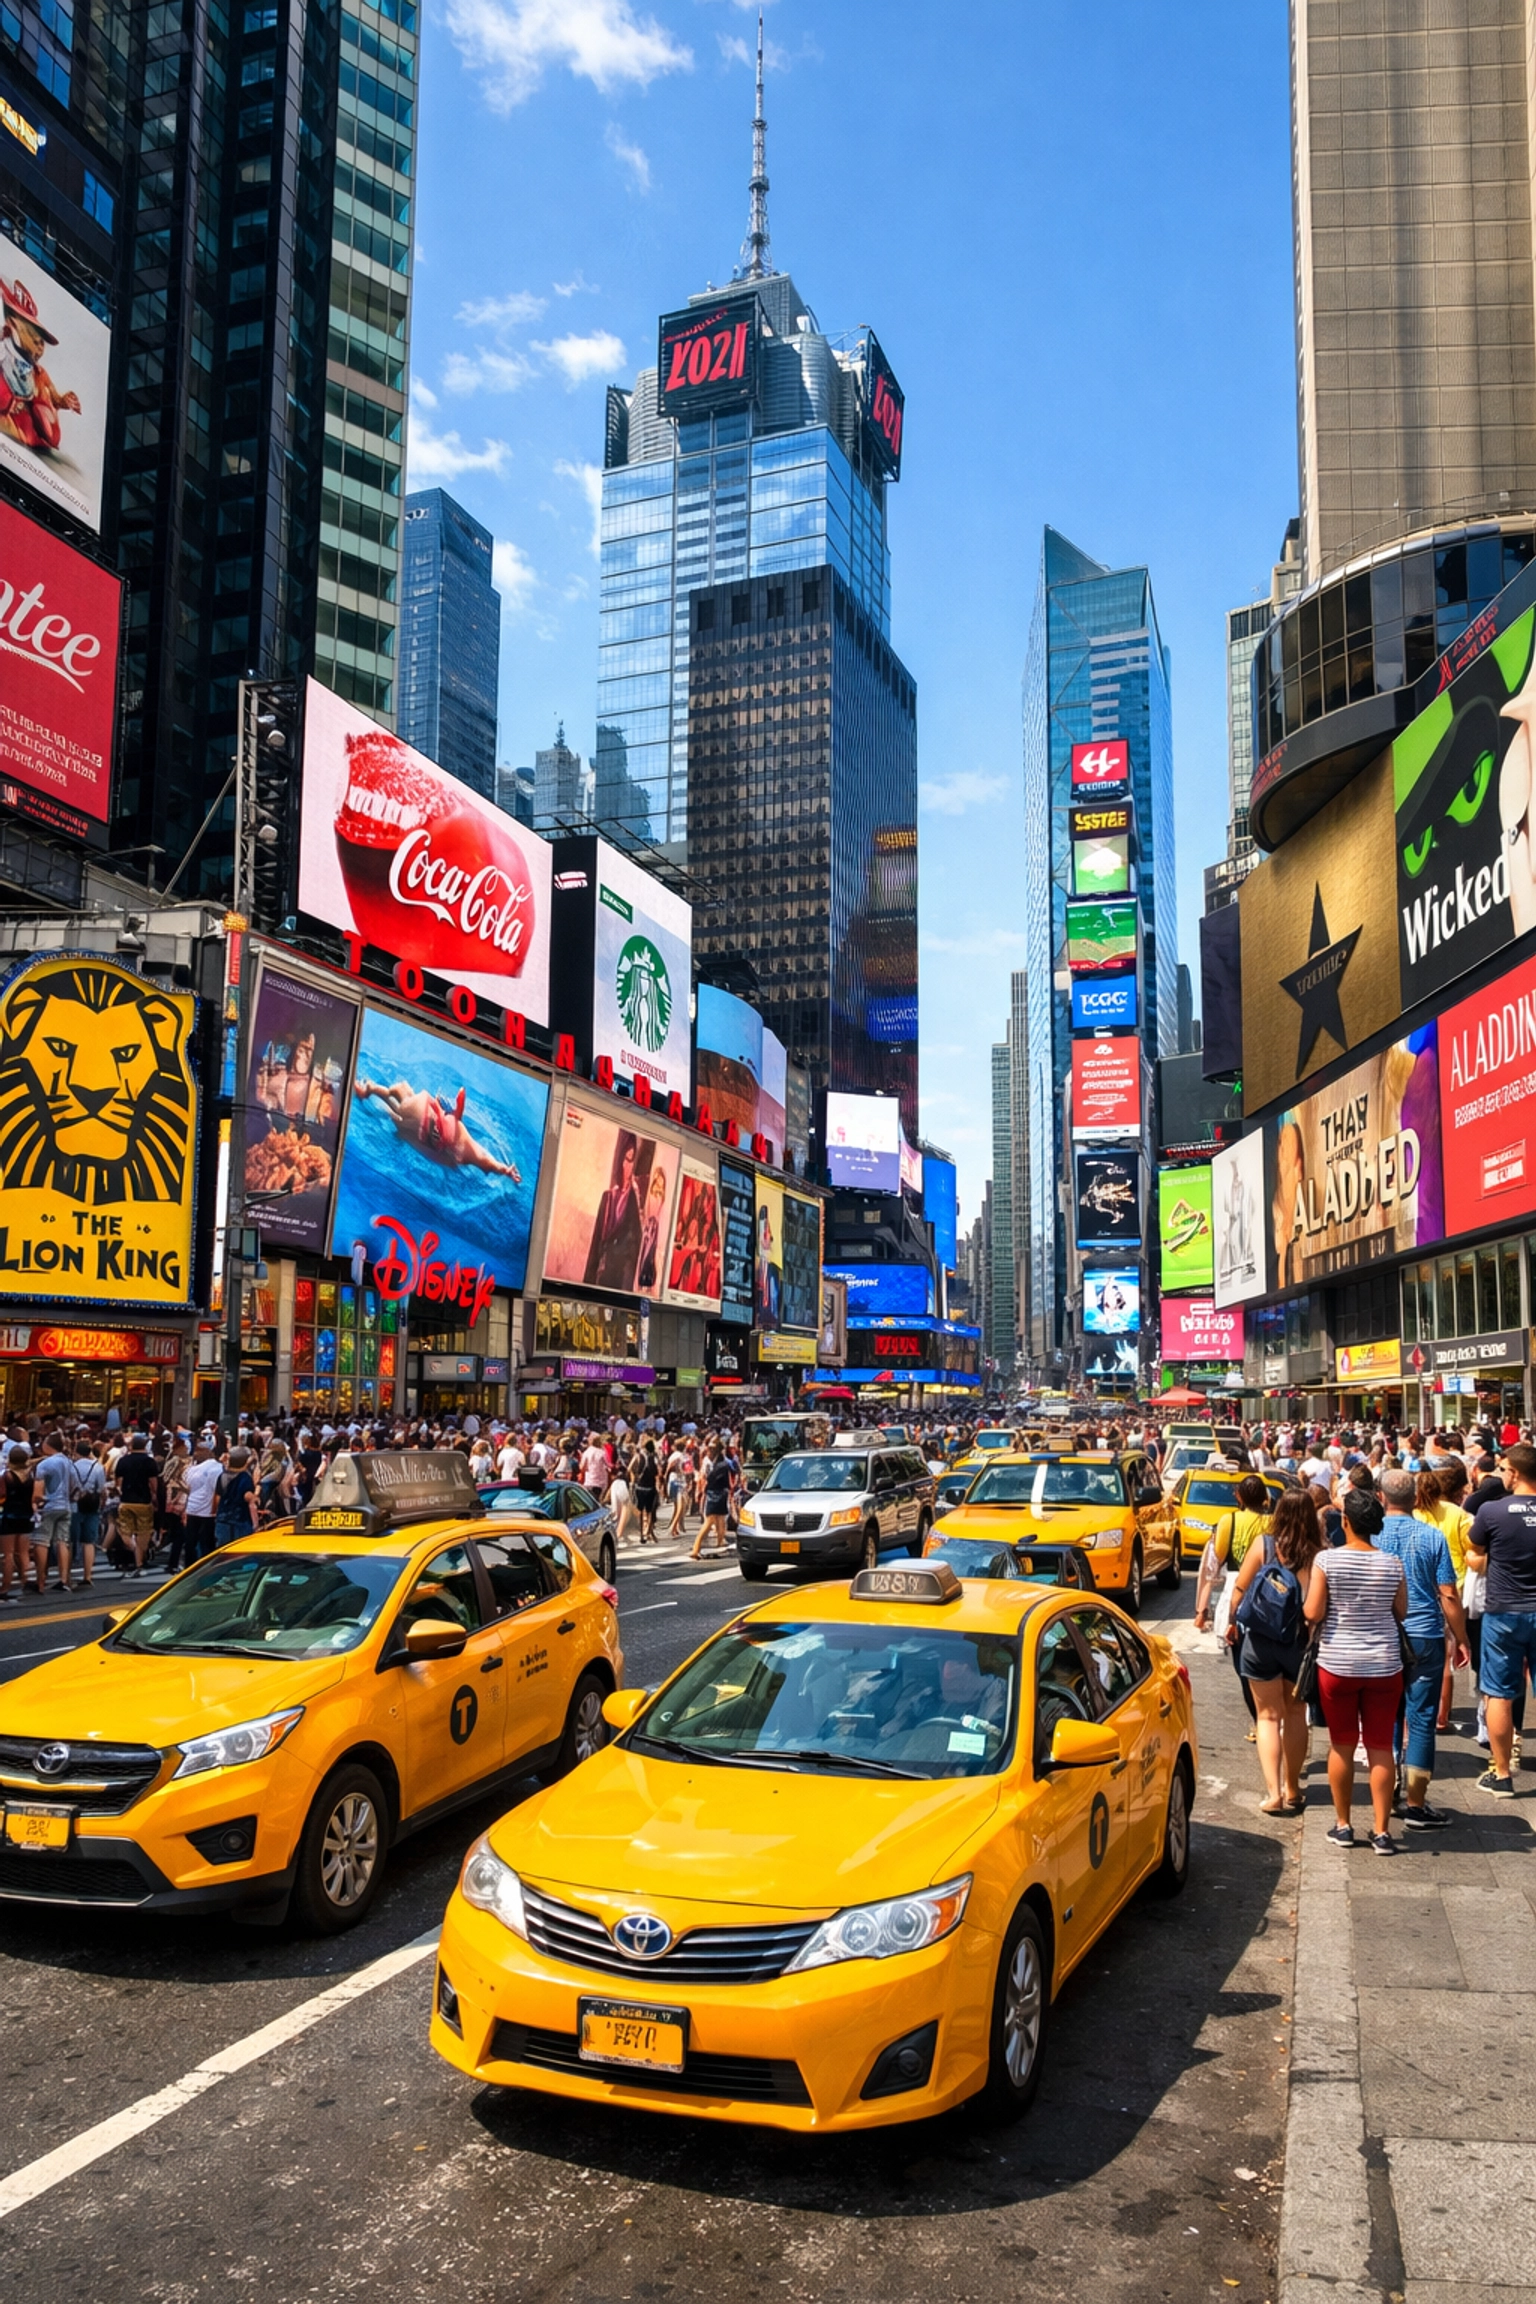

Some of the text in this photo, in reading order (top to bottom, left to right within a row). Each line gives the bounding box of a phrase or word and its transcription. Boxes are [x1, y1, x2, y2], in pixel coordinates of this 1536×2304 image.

[1402, 832, 1511, 966] Wicked
[72, 1211, 123, 1236] THE
[0, 1226, 181, 1289] LION KING
